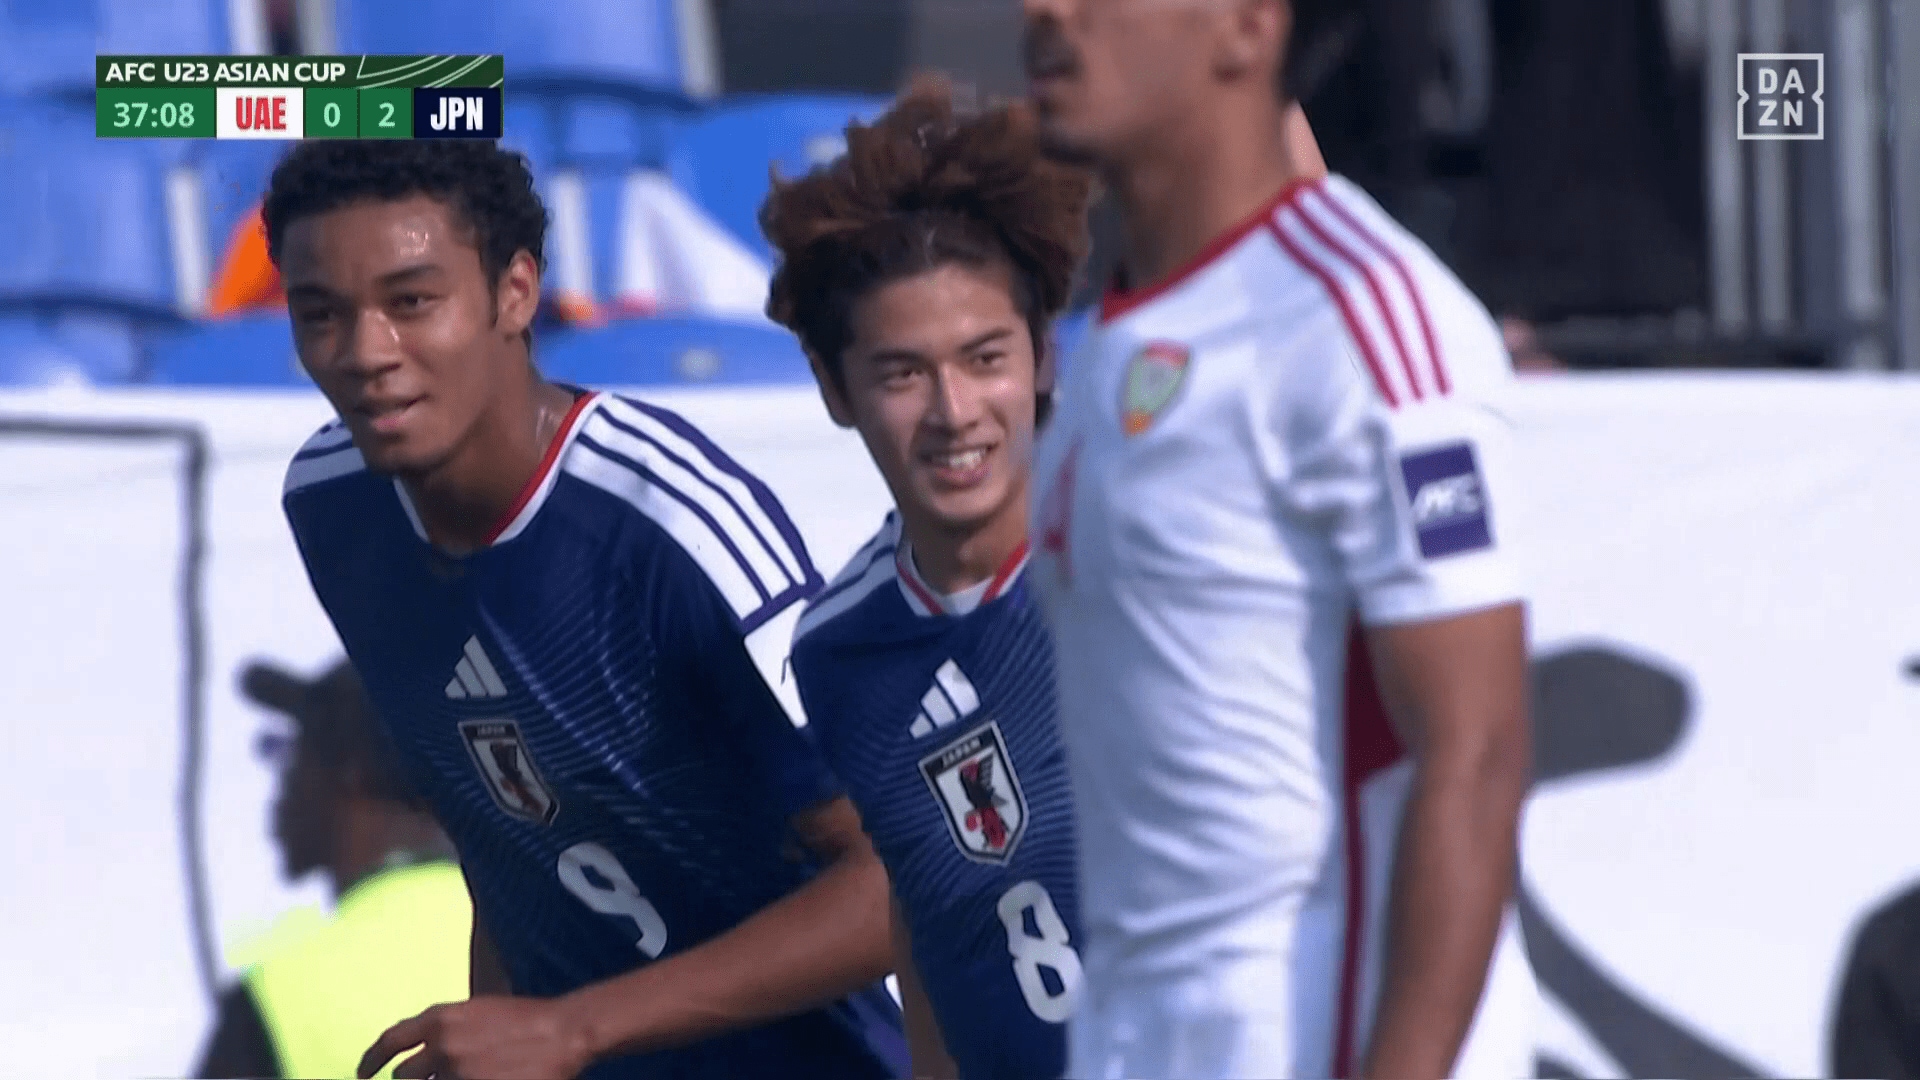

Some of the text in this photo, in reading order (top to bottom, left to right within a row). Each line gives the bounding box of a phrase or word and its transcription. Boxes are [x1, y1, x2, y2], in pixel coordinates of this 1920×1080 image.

[941, 736, 981, 768] JAPAN
[557, 842, 668, 959] 9
[997, 880, 1086, 1024] 8
